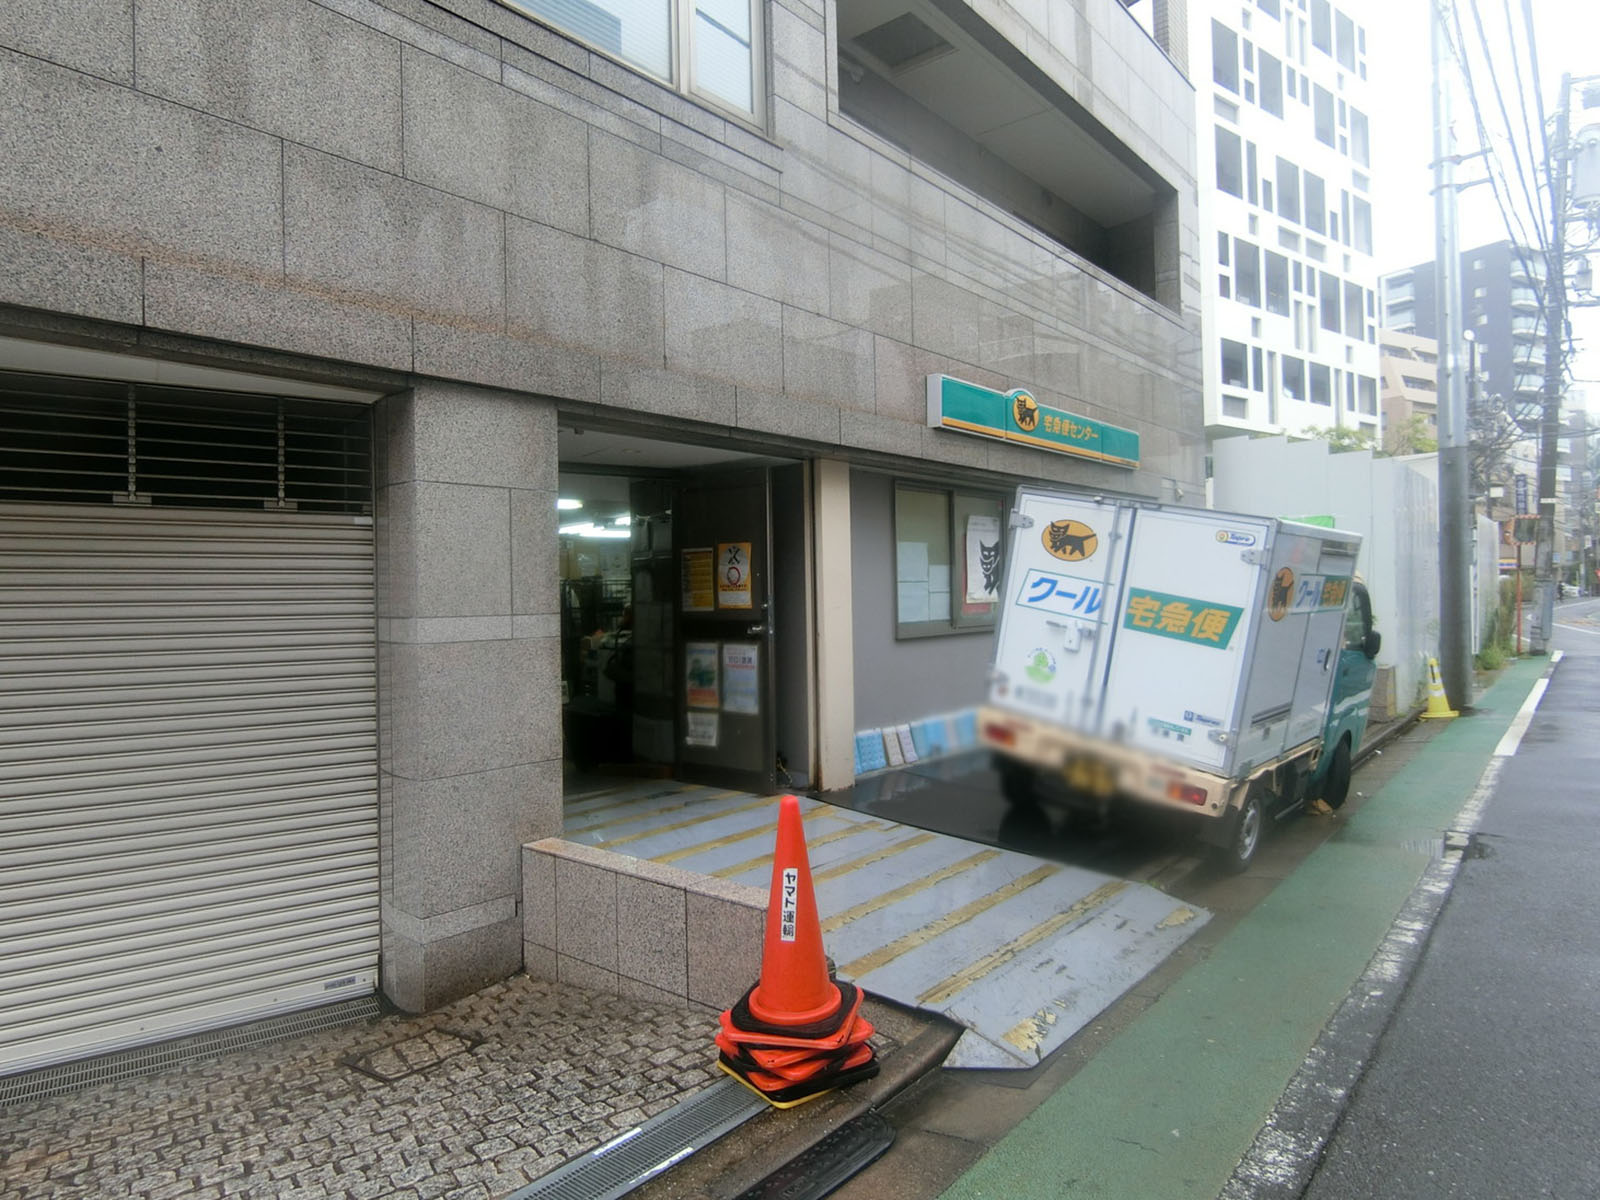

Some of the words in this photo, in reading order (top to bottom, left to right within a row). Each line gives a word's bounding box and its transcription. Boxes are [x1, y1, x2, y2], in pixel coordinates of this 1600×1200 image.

[1043, 415, 1099, 441] 宅急便センター
[1027, 577, 1103, 614] クール
[1127, 596, 1231, 642] 宅急便
[782, 872, 797, 937] ヤマト運輸
